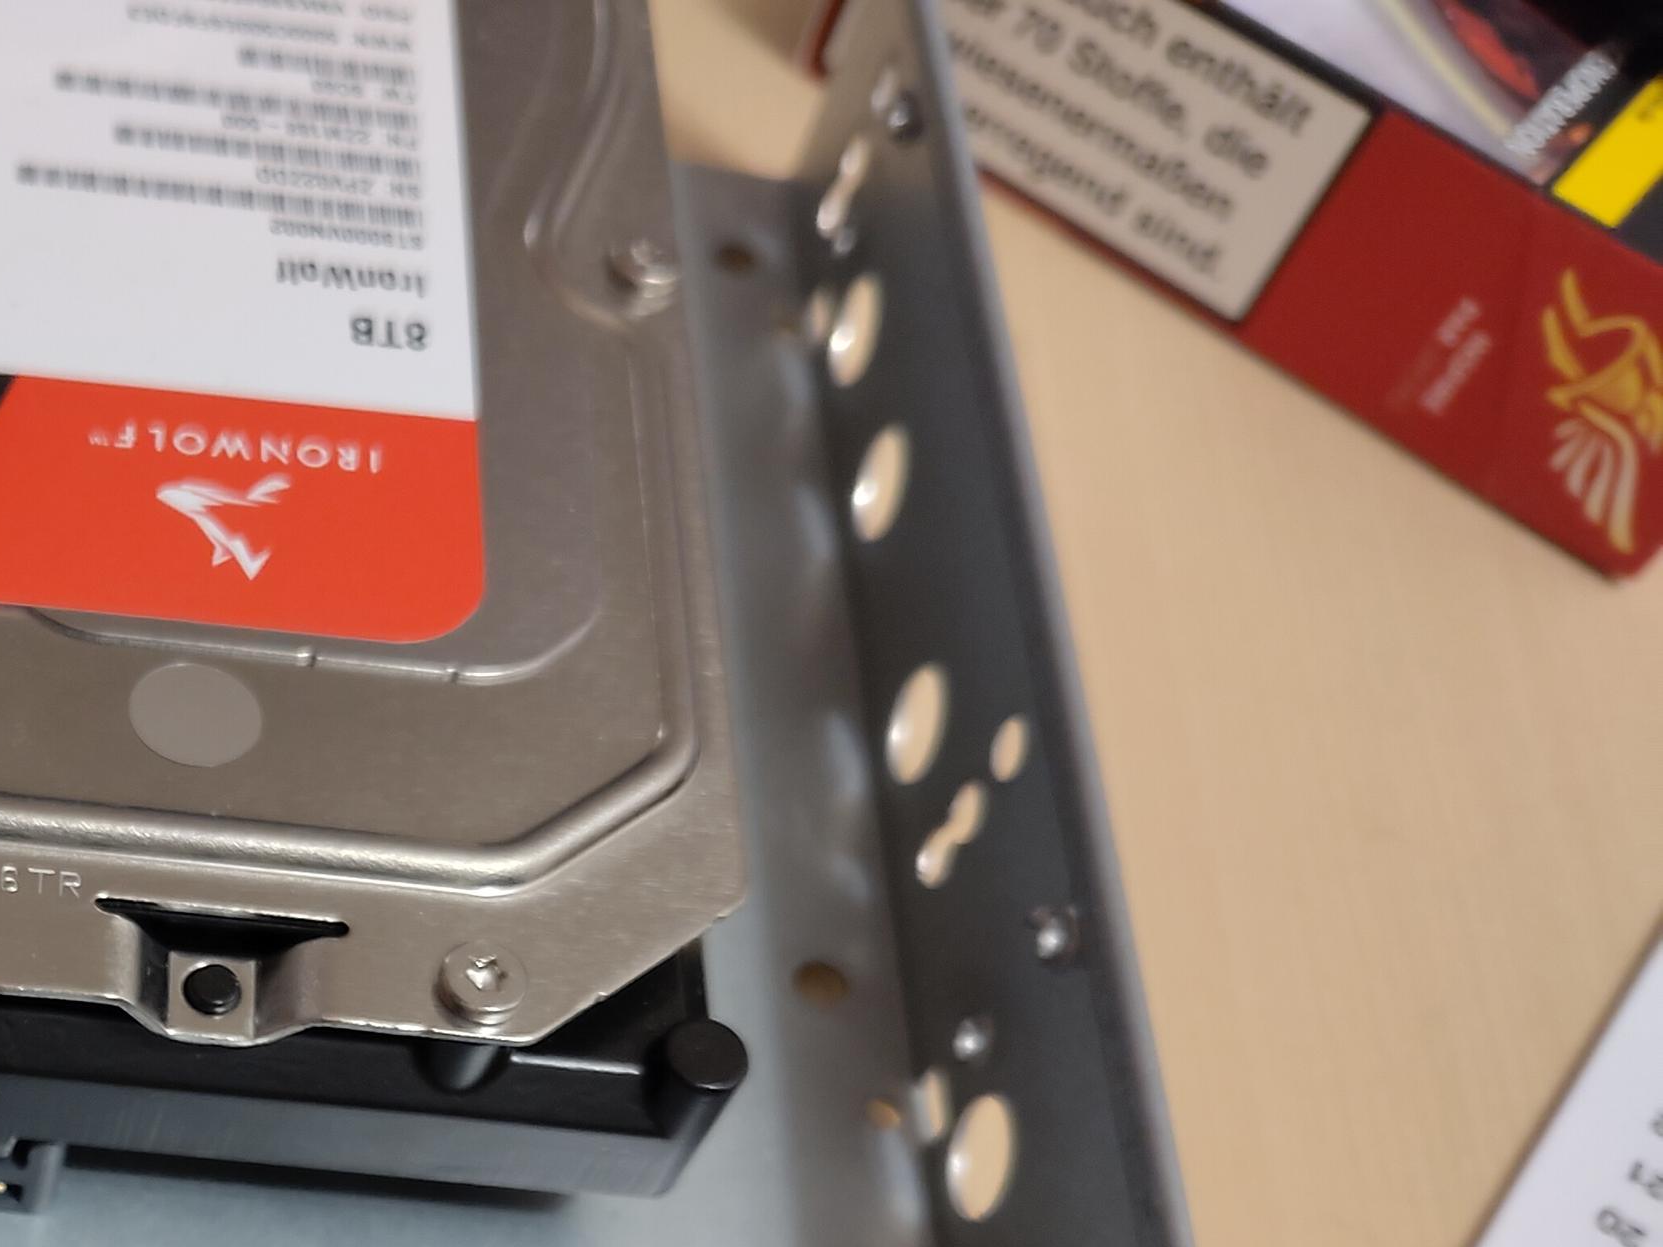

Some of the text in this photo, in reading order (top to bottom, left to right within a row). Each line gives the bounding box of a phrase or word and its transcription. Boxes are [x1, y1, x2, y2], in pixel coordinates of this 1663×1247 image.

[1203, 126, 1270, 178] die
[276, 257, 427, 298] IronWolf
[349, 315, 429, 352] 8TB
